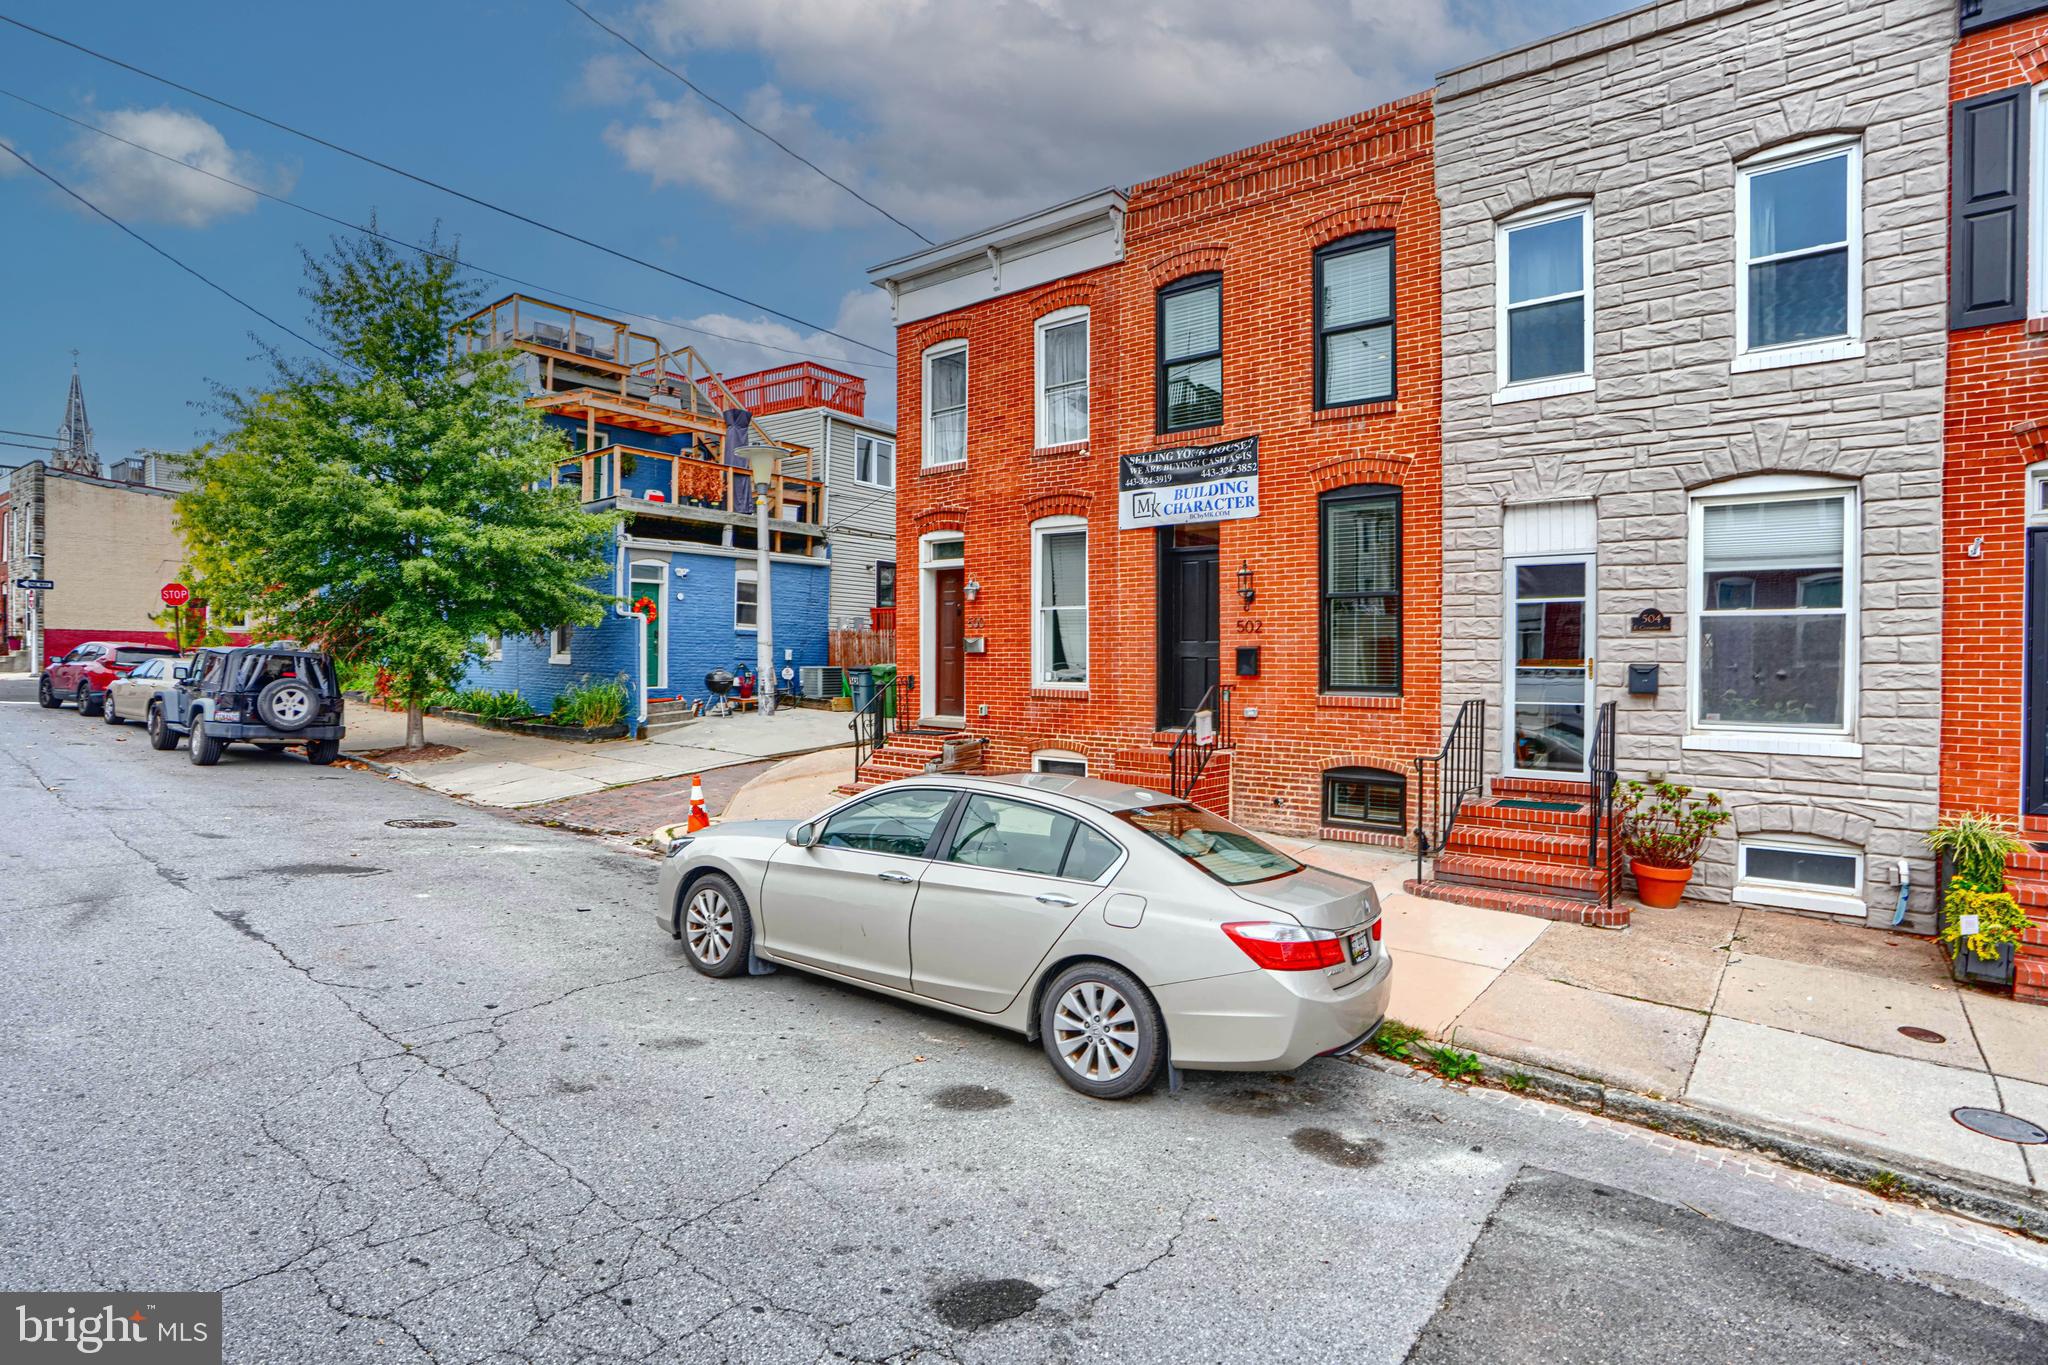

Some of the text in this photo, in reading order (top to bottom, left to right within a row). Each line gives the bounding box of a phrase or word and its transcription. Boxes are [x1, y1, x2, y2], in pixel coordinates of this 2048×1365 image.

[1129, 439, 1253, 465] SELLING YOUR HOUSE?
[1130, 466, 1144, 475] WE
[1145, 464, 1163, 474] ARE
[1202, 457, 1227, 467] CASH
[1201, 463, 1257, 478] 443-324-3852
[1125, 474, 1172, 487] 443-324-3919
[1174, 481, 1248, 501] BUILDING
[1163, 496, 1255, 515] CHARACTER
[163, 590, 188, 600] STOP
[1236, 620, 1263, 633] 502
[1642, 614, 1662, 624] 504
